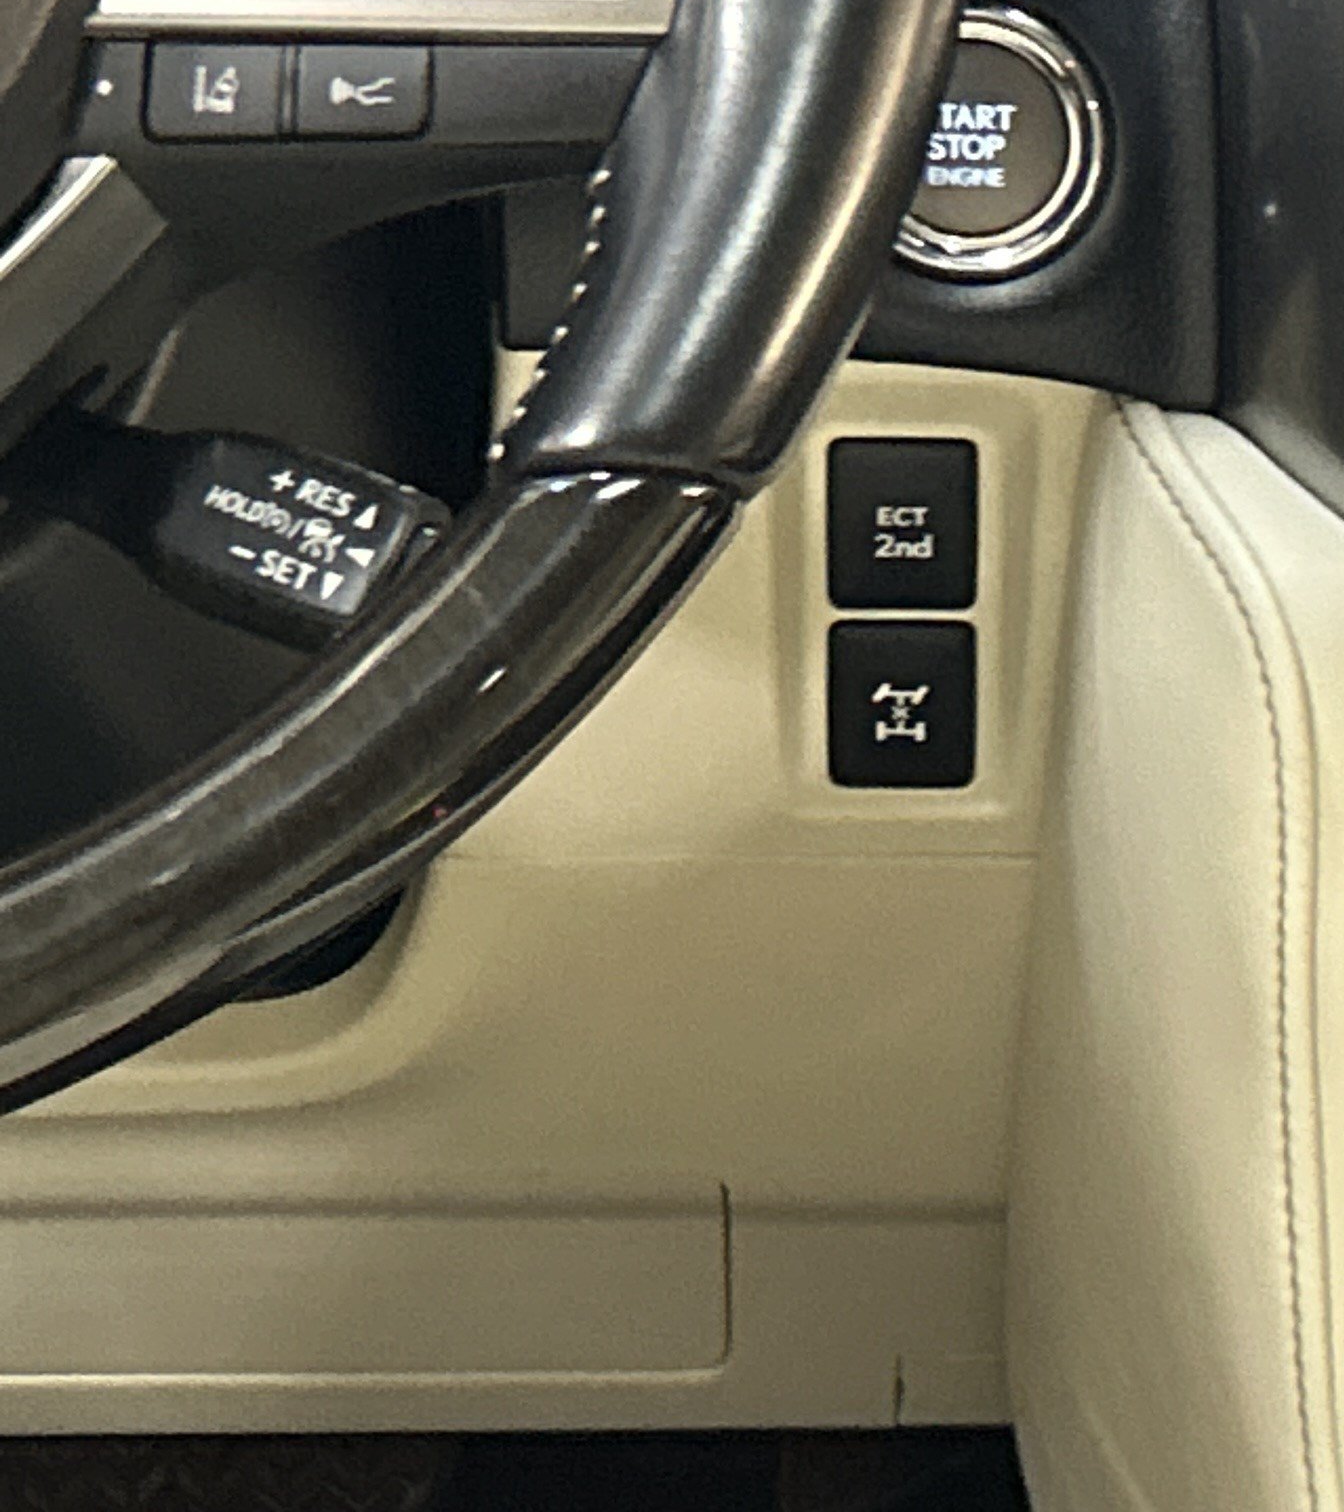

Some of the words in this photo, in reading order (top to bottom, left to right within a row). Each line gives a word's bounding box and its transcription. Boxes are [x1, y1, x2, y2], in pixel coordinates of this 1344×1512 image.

[940, 102, 1019, 131] TART
[927, 133, 1007, 161] STOP
[876, 506, 929, 528] ECT
[875, 533, 933, 559] 2nd
